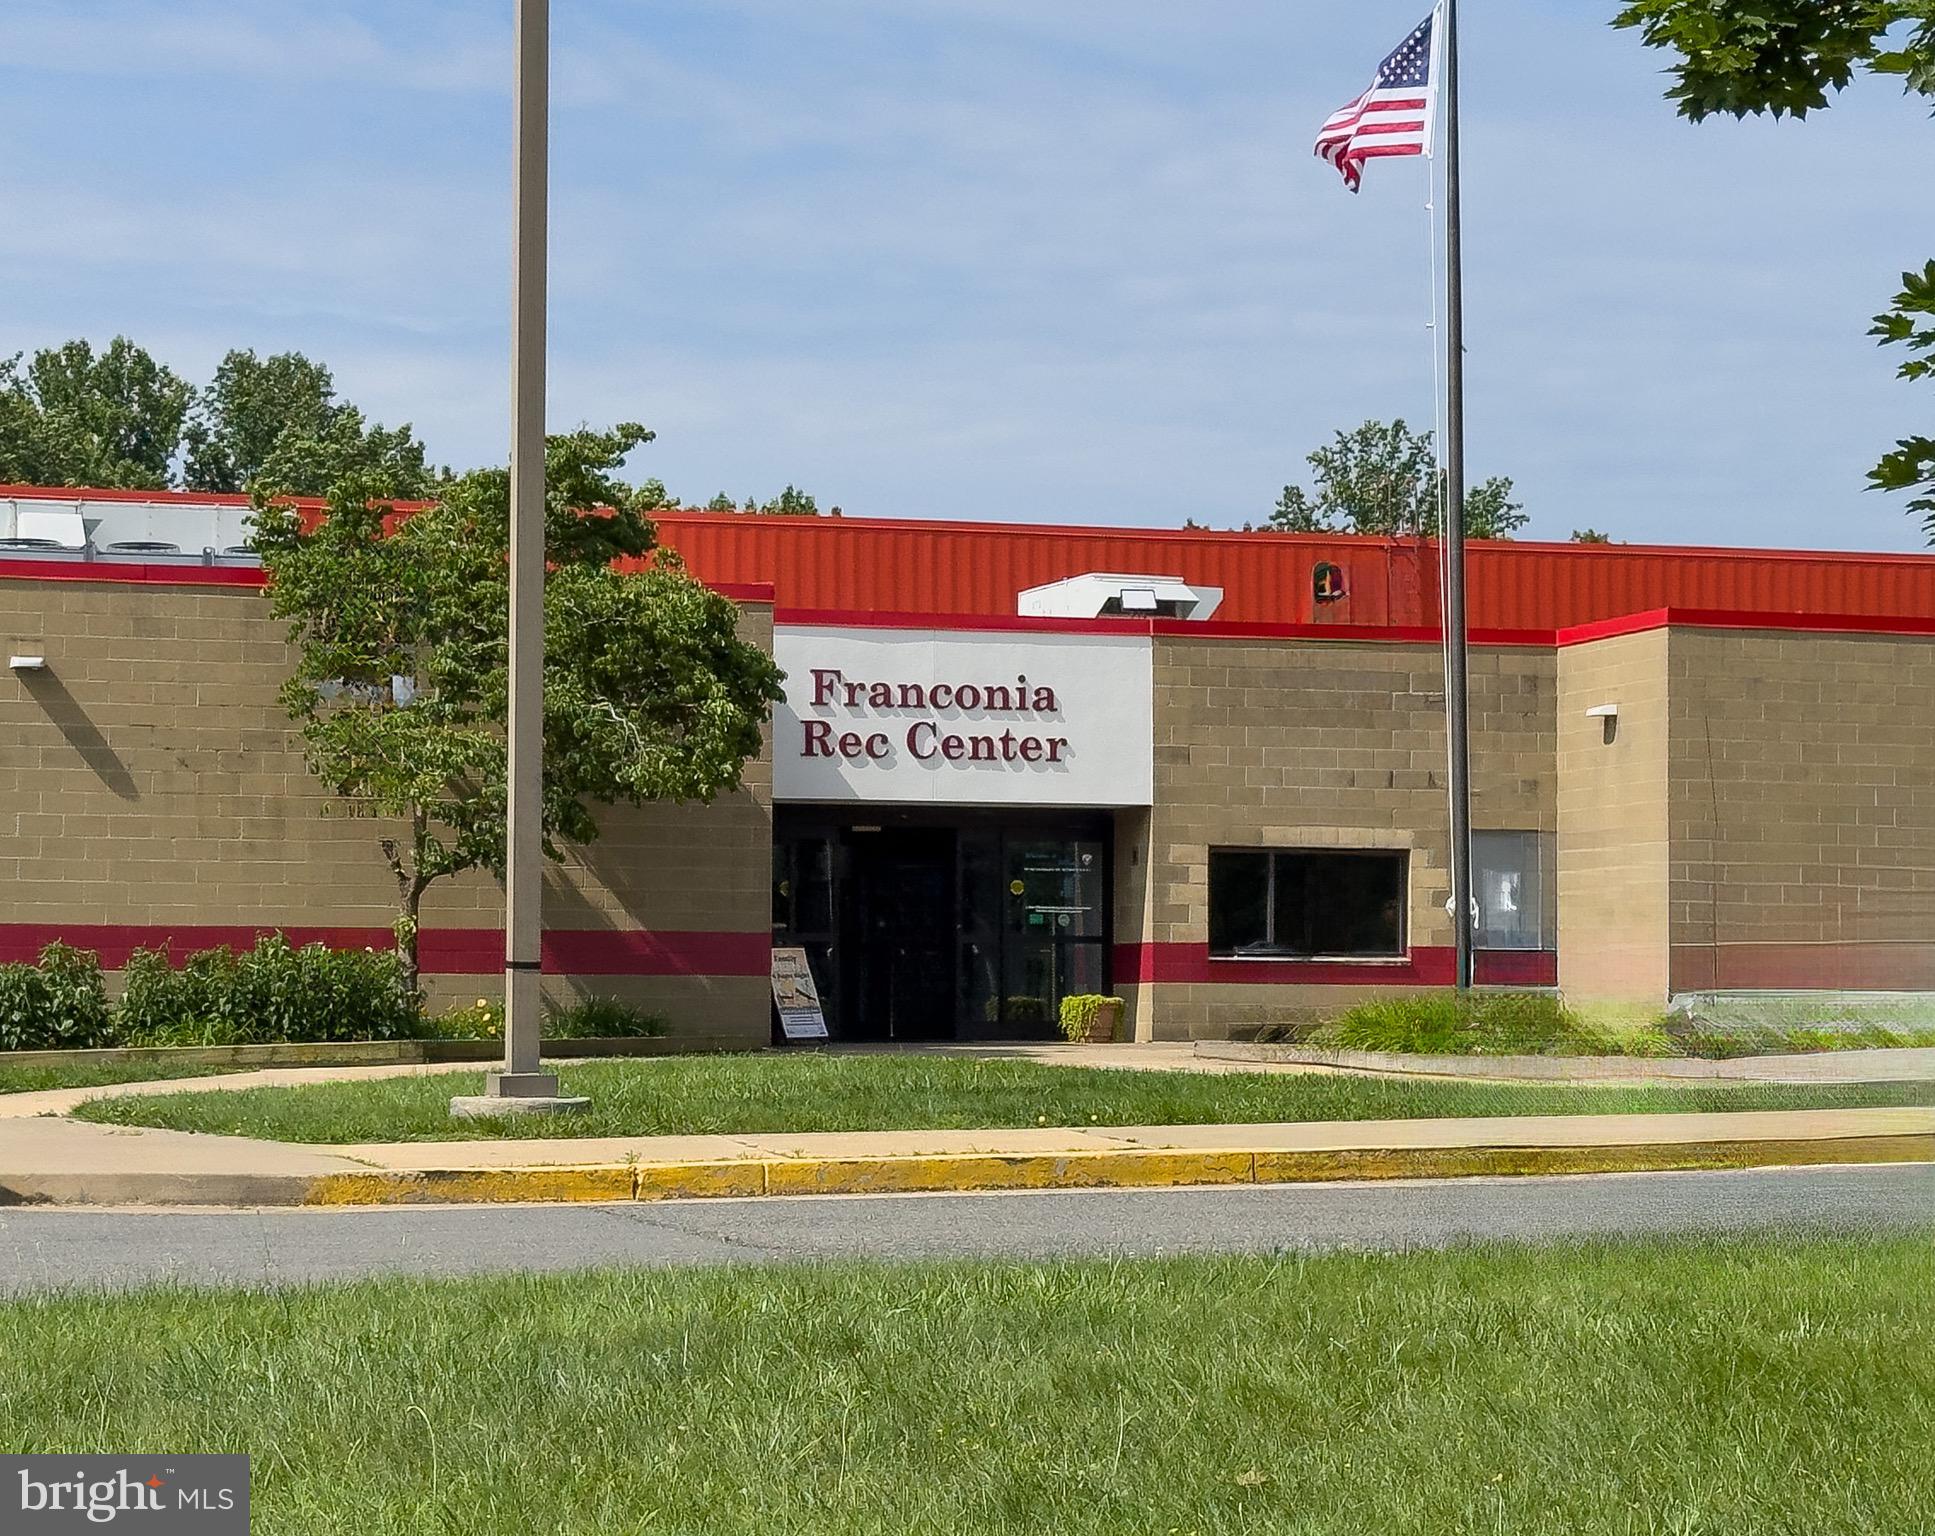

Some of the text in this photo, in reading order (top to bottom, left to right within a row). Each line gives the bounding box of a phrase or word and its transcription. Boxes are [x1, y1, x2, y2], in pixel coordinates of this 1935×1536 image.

[809, 669, 1058, 712] Franconia
[800, 720, 1067, 763] Rec Center
